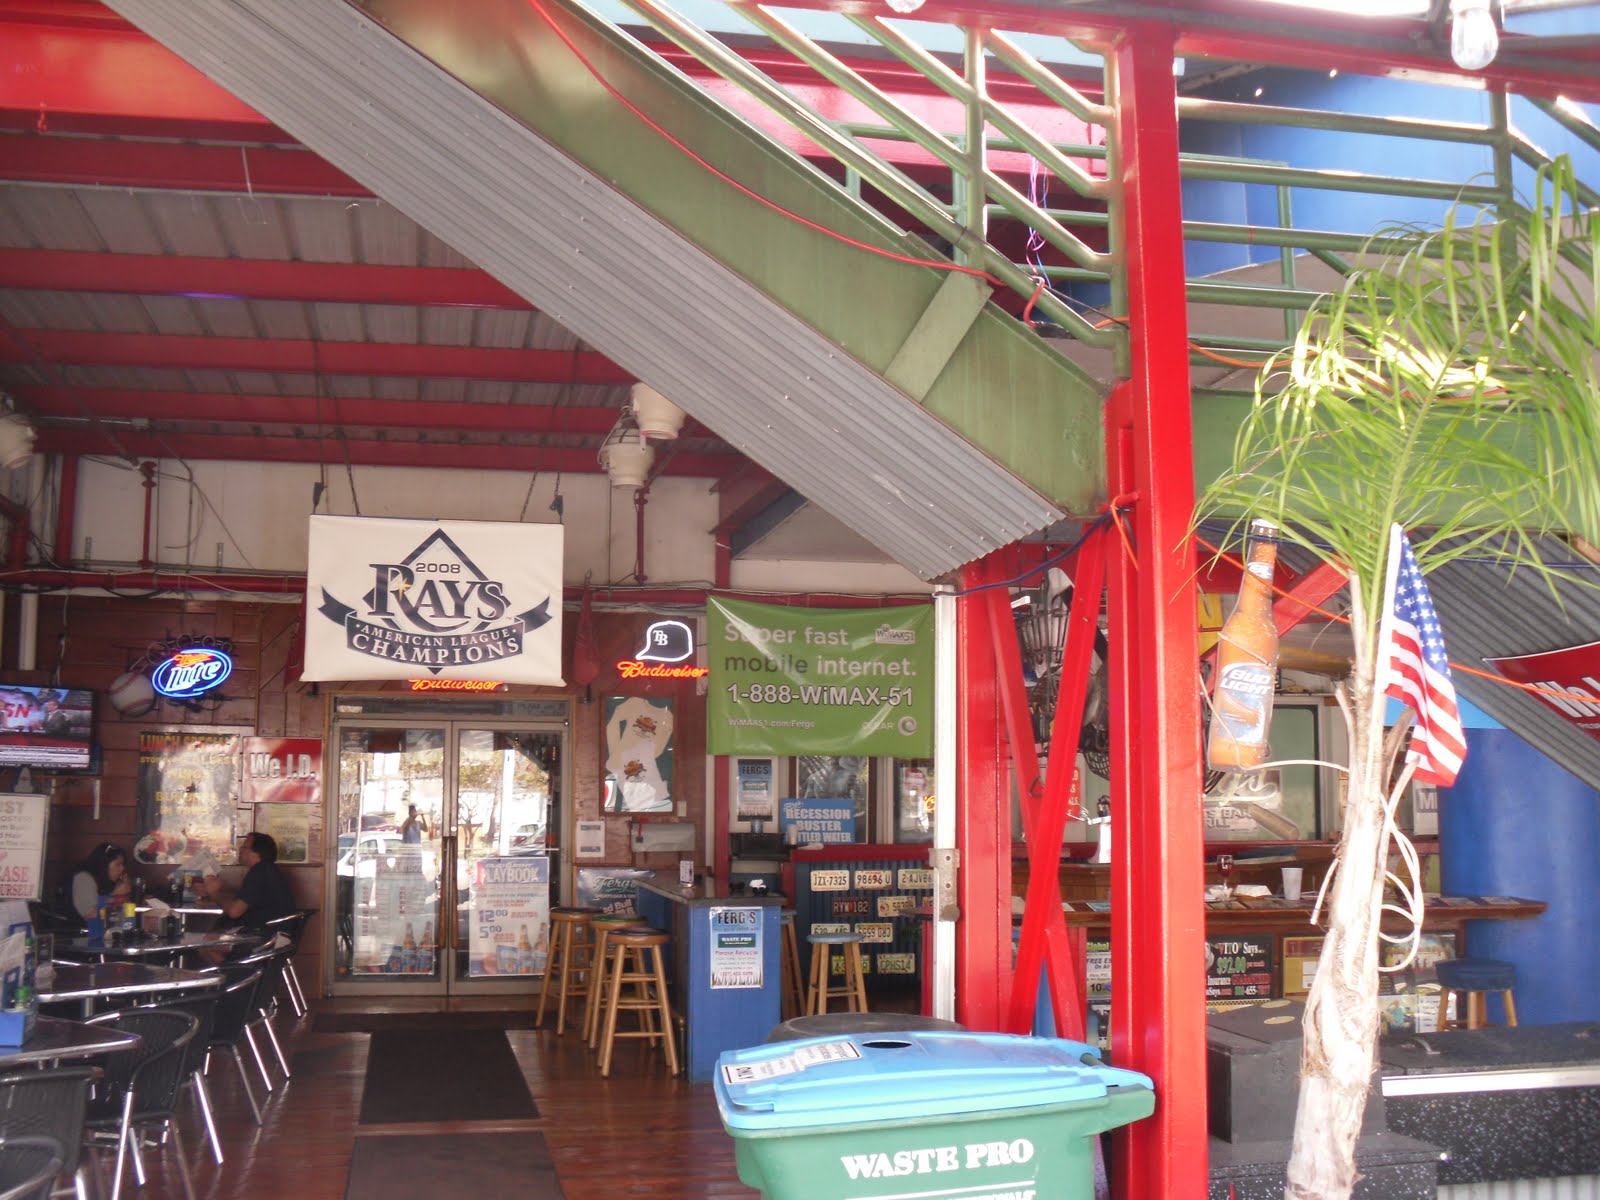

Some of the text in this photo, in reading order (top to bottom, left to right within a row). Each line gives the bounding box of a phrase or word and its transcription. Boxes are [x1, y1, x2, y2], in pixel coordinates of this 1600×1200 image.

[415, 562, 461, 574] 2008
[368, 563, 506, 632] RAYS
[361, 625, 510, 647] AMERICAN LEAGUE
[804, 626, 848, 646] fast
[352, 633, 519, 664] CHAMPIONS
[617, 661, 709, 679] Budweiser
[725, 655, 917, 677] mobile internet.
[164, 661, 222, 692] Lite
[408, 679, 503, 692] Budweiser
[1229, 668, 1272, 684] BUD
[727, 683, 913, 706] 1-888-WiMAX-51
[1220, 678, 1274, 695] LIGHT
[250, 753, 317, 779] We I.D.
[786, 808, 851, 820] RECESSION
[1204, 818, 1231, 828] RILL
[796, 820, 842, 832] BUSTER
[823, 832, 852, 843] WATER
[840, 1138, 1035, 1180] WASTE PRO
